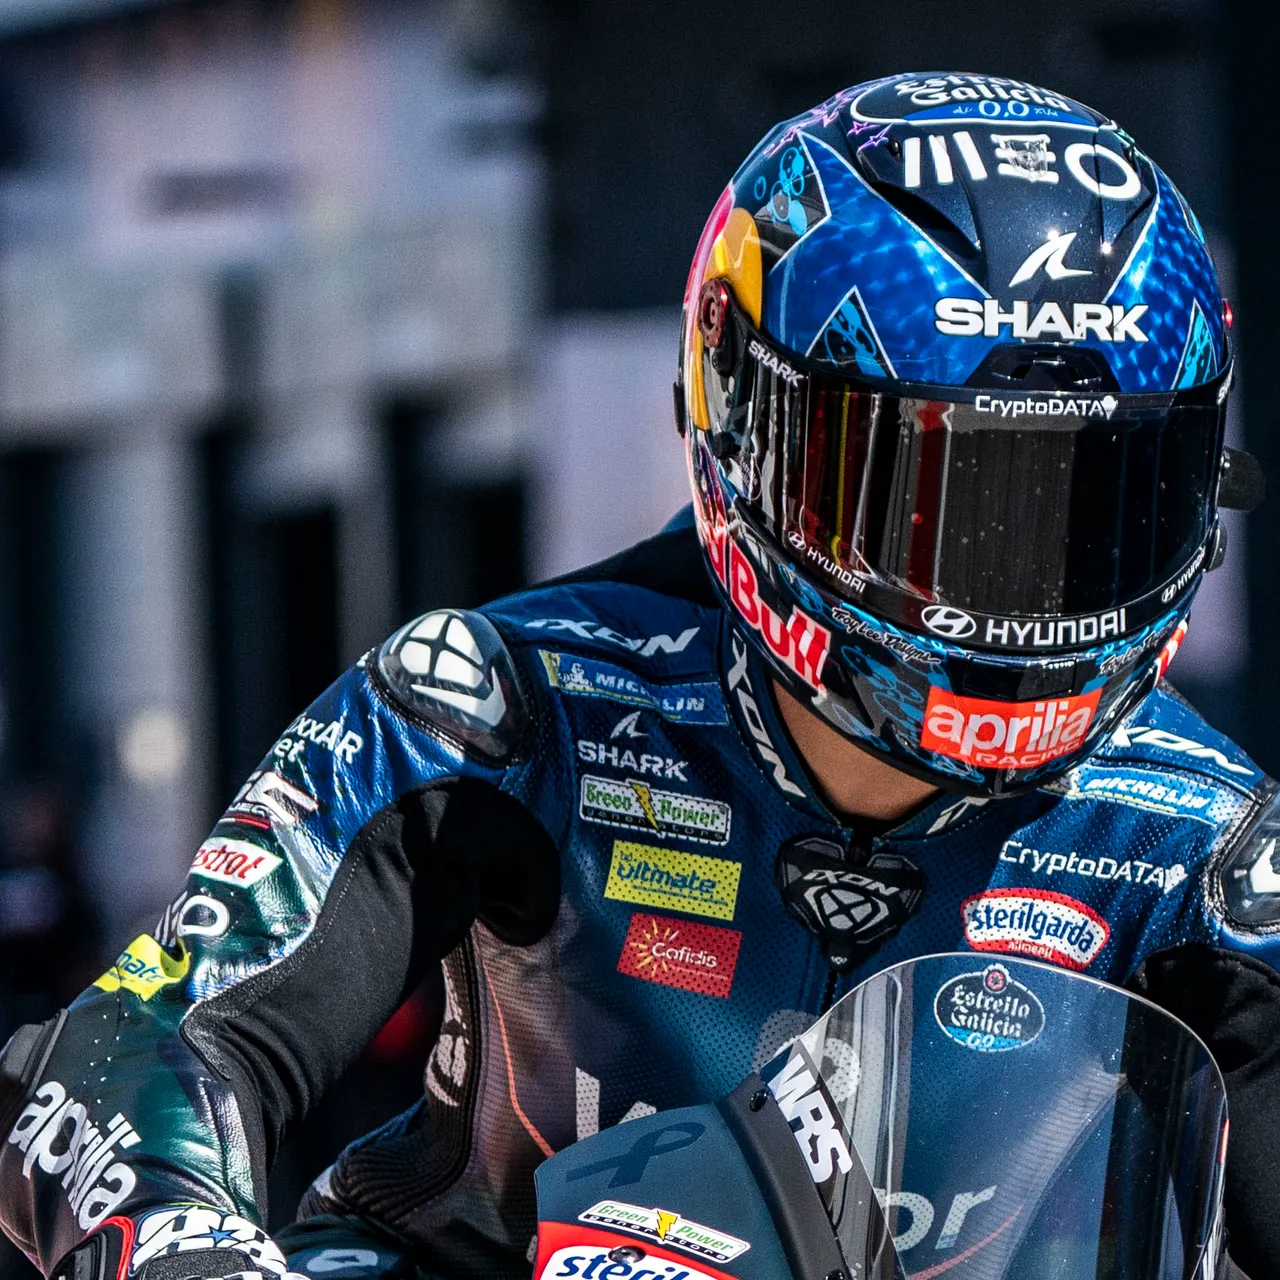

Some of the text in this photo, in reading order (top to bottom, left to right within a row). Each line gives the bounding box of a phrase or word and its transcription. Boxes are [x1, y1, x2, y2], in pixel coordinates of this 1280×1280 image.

[910, 83, 1072, 112] Galicia
[935, 299, 1150, 343] SHARK
[747, 339, 803, 388] SHARK
[975, 395, 1105, 420] CryptoDATA
[807, 547, 867, 594] HYUNDAI
[986, 608, 1126, 648] HYUNDAI
[926, 700, 1093, 758] aprilia
[577, 738, 690, 783] SHARK
[973, 740, 1082, 769] RACING
[585, 782, 721, 829] Green Power
[1083, 776, 1213, 810] MICHELIN
[1000, 839, 1167, 885] CryptoDATA
[971, 901, 1095, 953] sterilgarda
[651, 942, 718, 968] Cofidis
[767, 1053, 853, 1184] WRS
[9, 1080, 137, 1232] aprilia
[598, 1204, 734, 1252] Green Power
